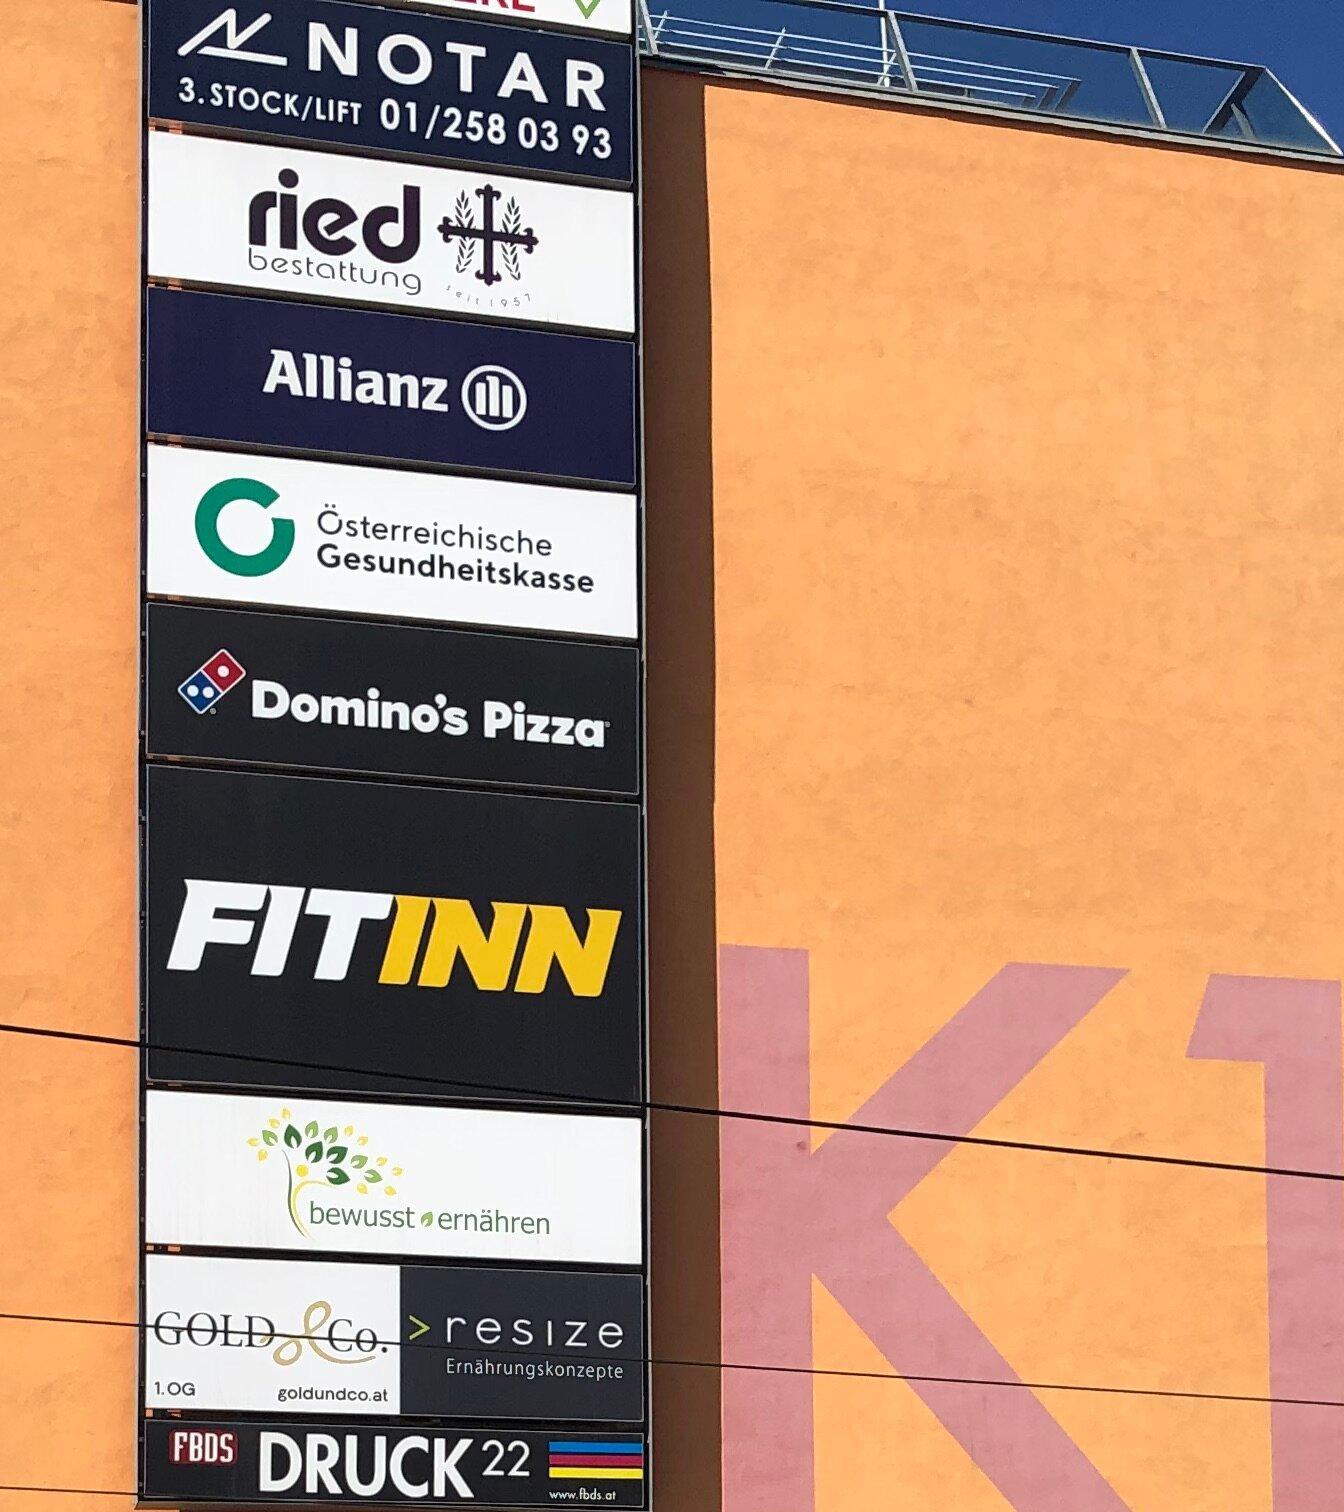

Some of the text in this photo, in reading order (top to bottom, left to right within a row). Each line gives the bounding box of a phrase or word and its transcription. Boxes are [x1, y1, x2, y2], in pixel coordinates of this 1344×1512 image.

[307, 22, 607, 112] NOTAR
[380, 98, 506, 145] 01/258
[518, 117, 559, 151] 03
[574, 126, 612, 159] 93
[248, 168, 421, 264] ried
[248, 247, 422, 296] bestattung
[262, 349, 448, 413] Allianz
[317, 503, 553, 557] Österreichische
[317, 545, 595, 593] Gesundheitskasse
[252, 680, 605, 748] Domino's Pizza
[310, 1201, 551, 1235] bewusst ernähren
[446, 1315, 624, 1350] resize
[277, 1385, 389, 1404] goldundco.at
[446, 1358, 624, 1383] Ernährungskonzepte
[174, 1432, 531, 1499] FBDS DRUCK 22
[549, 1488, 616, 1501] www.fbds.at
